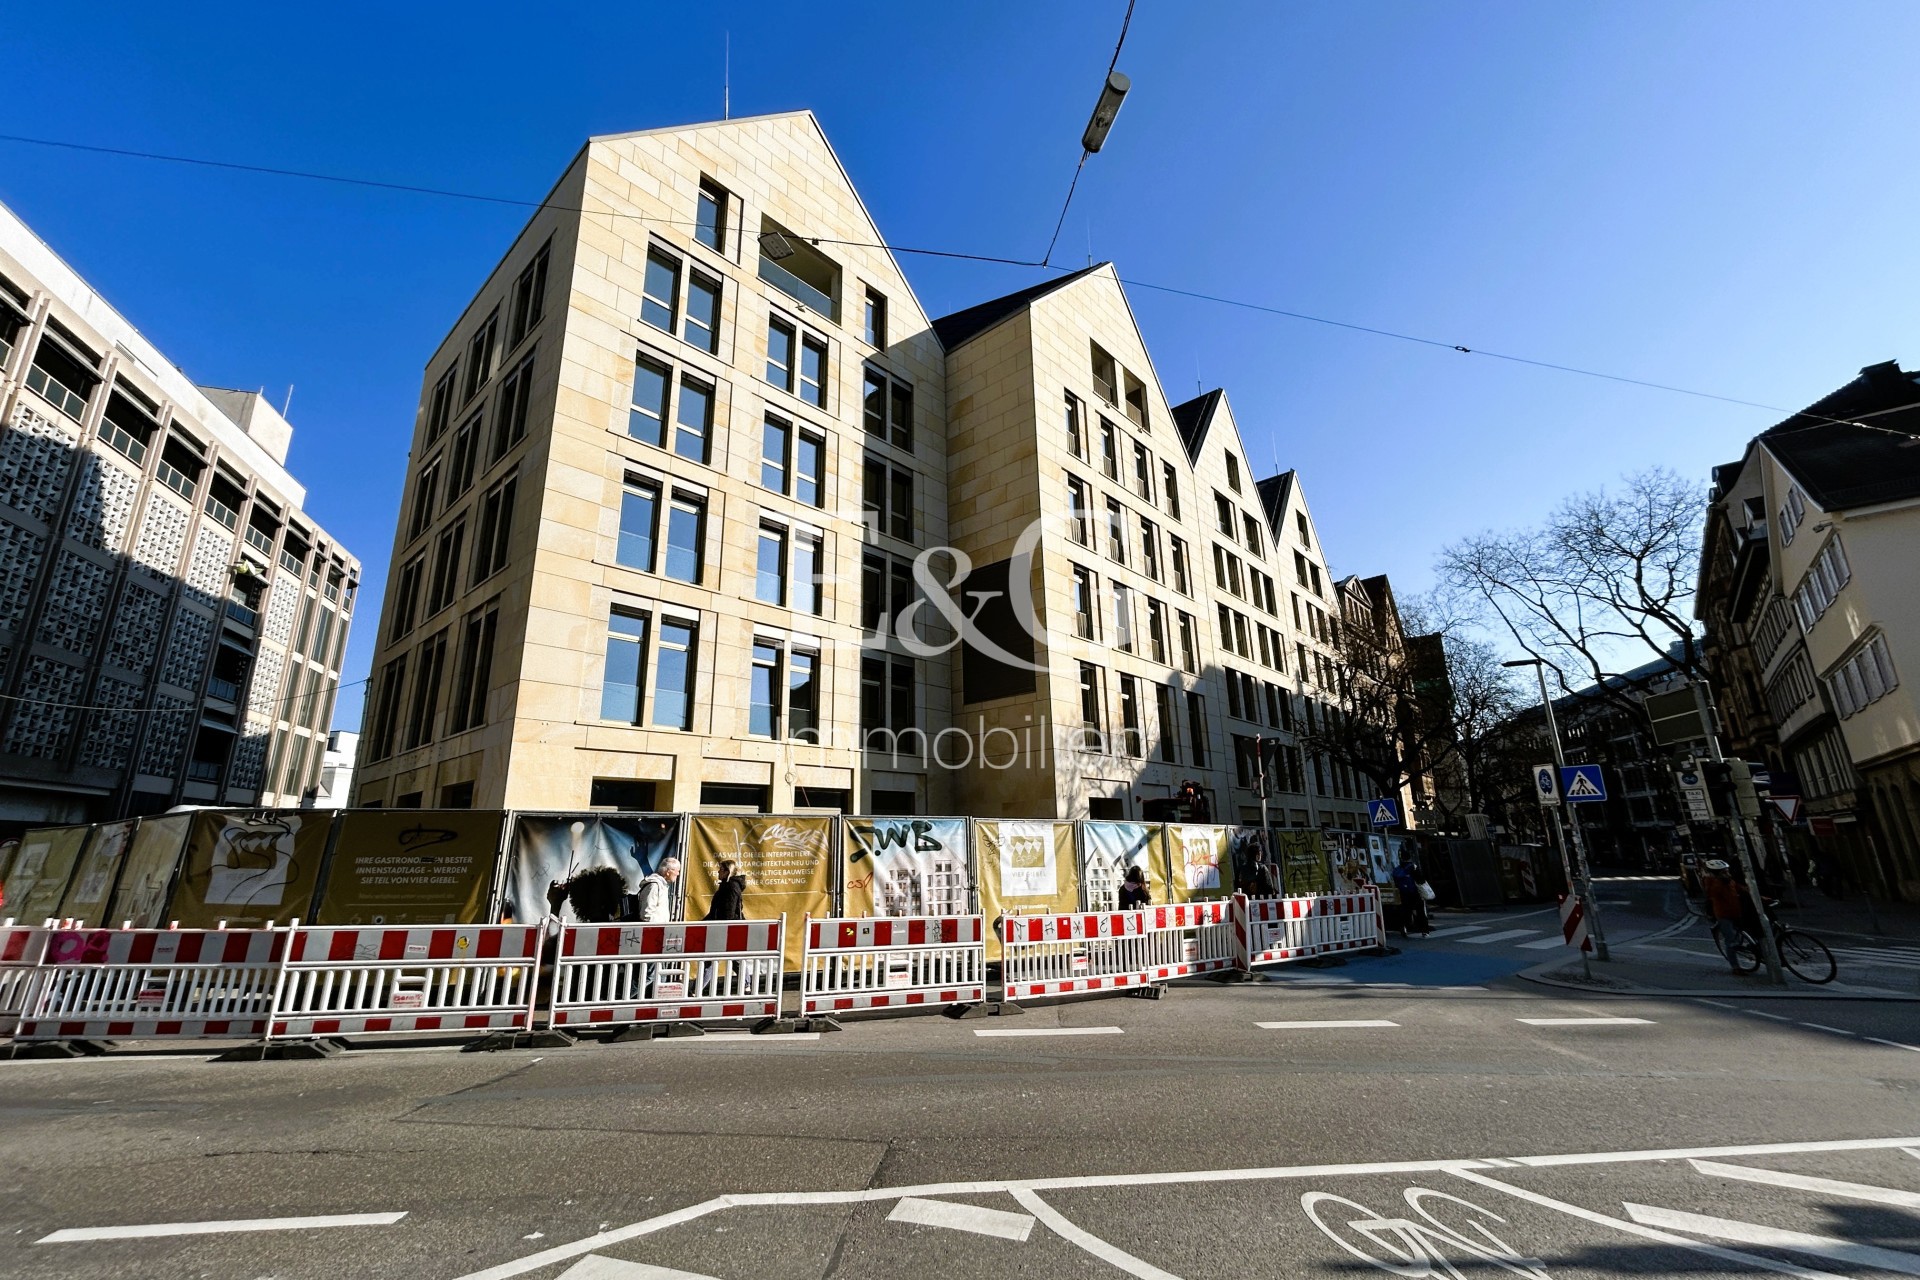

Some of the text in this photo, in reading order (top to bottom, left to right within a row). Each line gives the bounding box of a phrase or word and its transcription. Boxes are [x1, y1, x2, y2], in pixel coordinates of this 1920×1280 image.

[355, 856, 374, 864] IHRE
[375, 856, 433, 864] GASTRONO
[444, 856, 473, 864] BESTER
[355, 866, 426, 874] INNENSTADTLAGE
[433, 866, 468, 874] WERDEN
[360, 876, 459, 884] SIE TEIL VON VIER GIEBEL.
